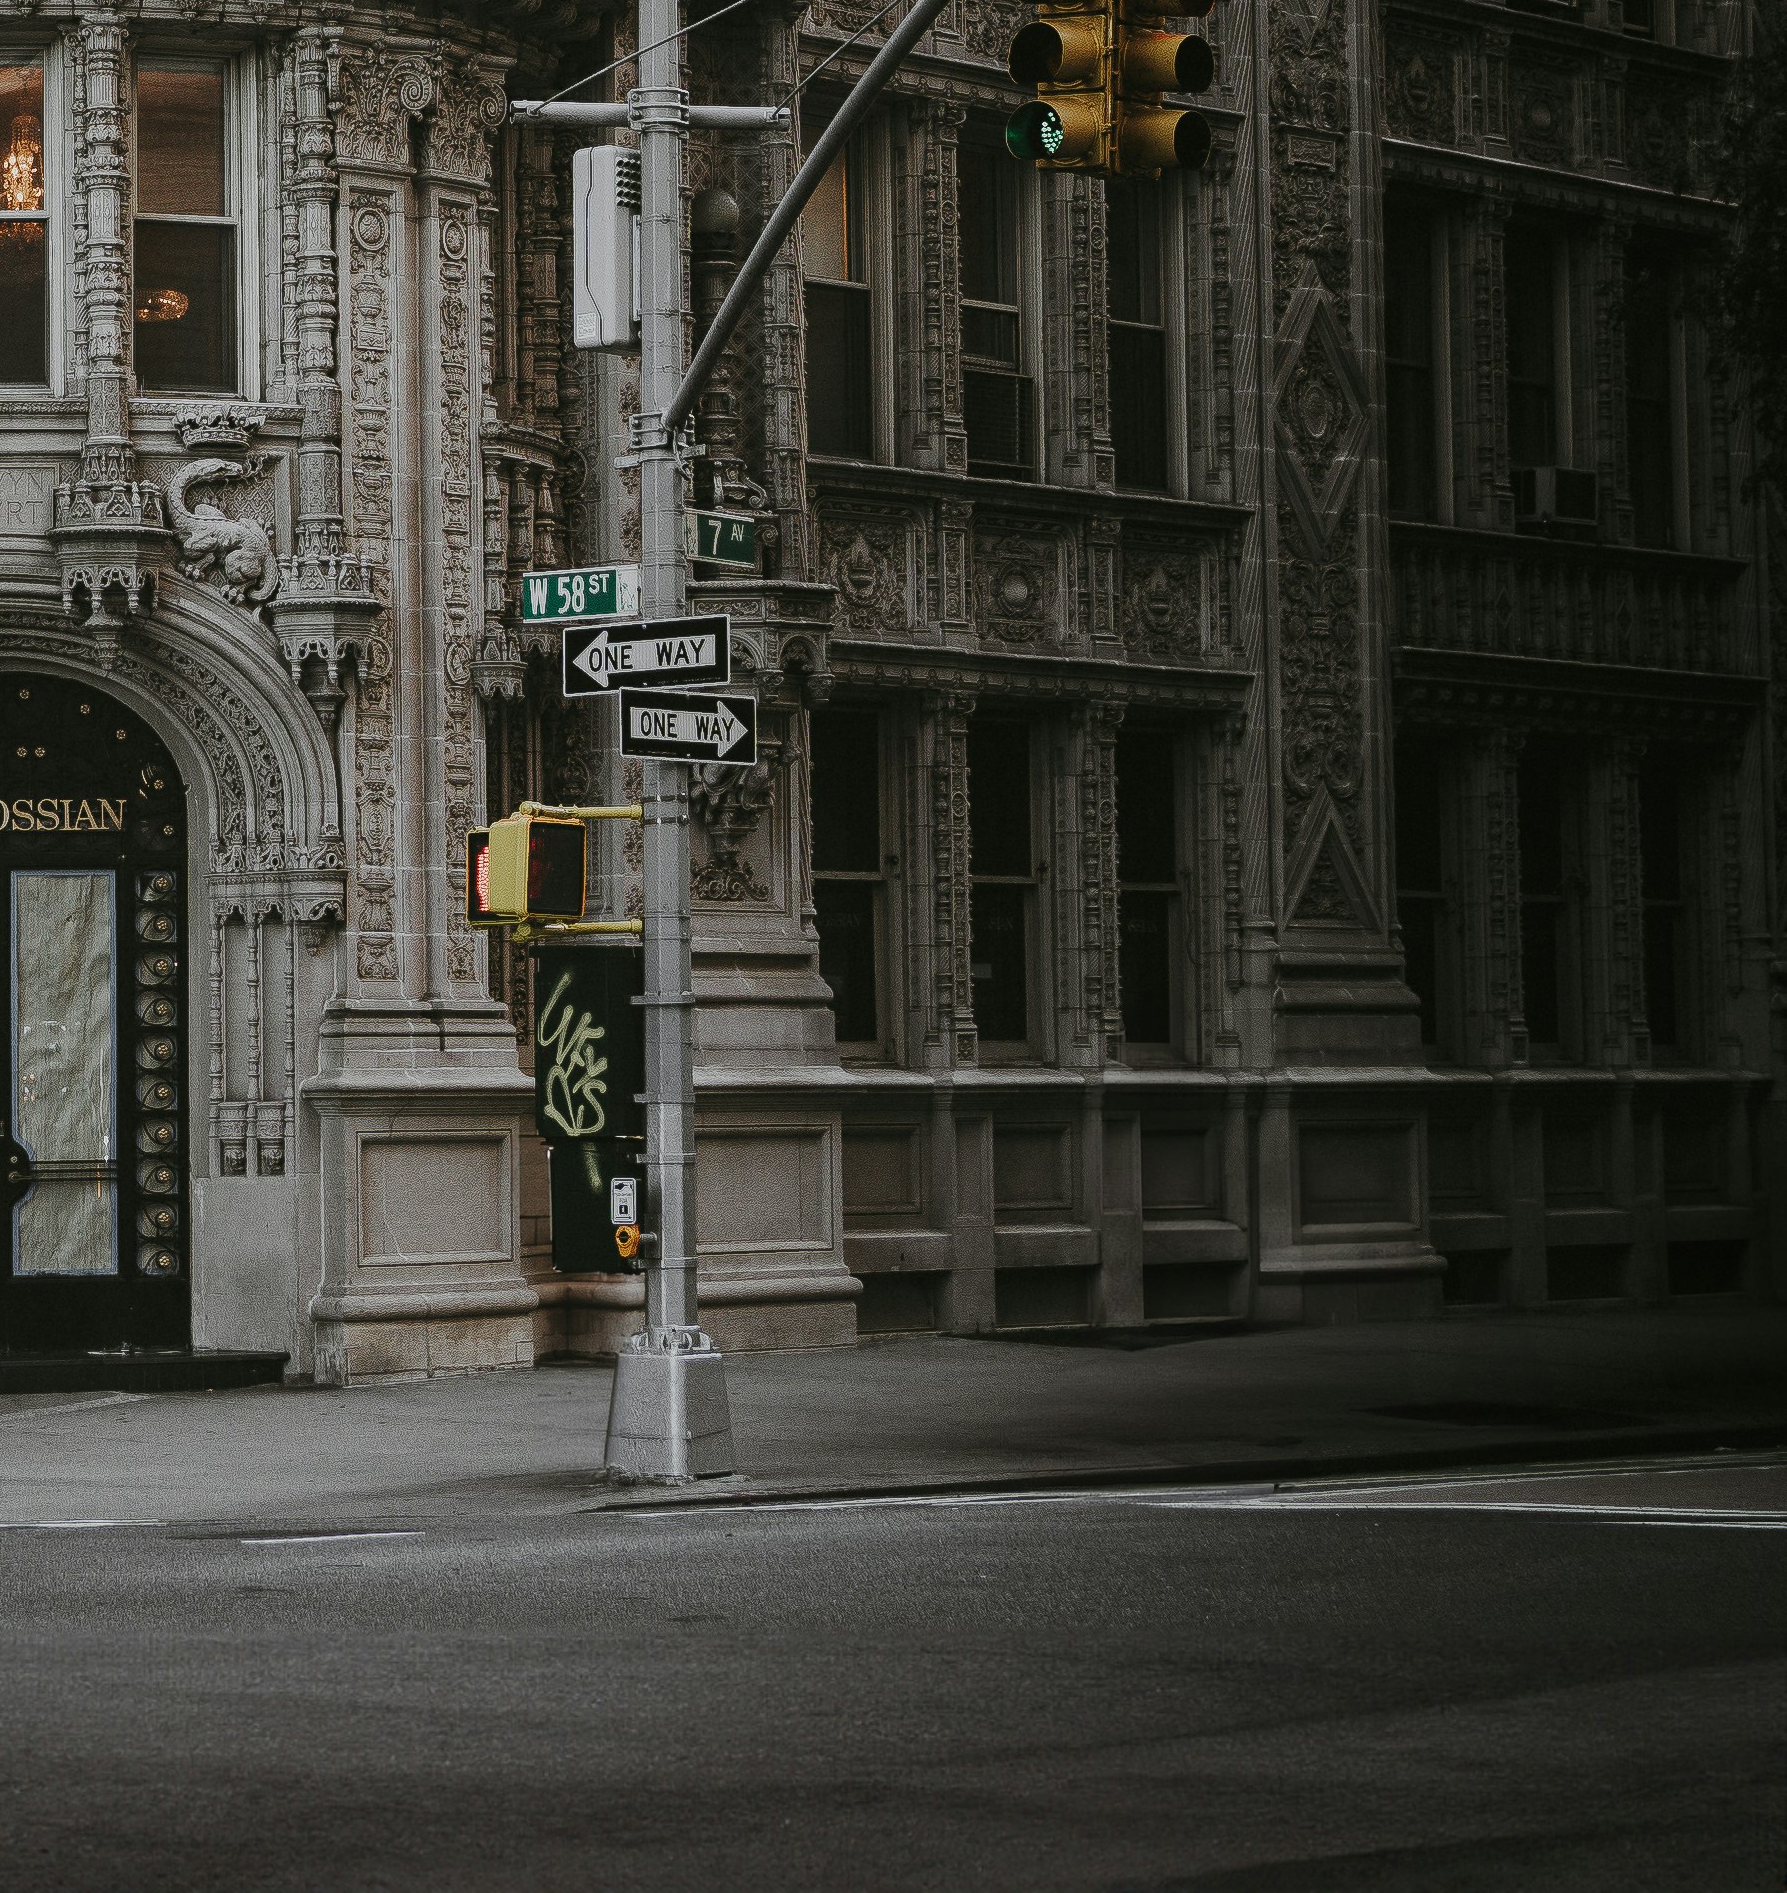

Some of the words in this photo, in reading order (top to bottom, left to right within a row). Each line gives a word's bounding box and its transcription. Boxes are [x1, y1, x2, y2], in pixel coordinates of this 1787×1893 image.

[707, 519, 722, 556] 7
[730, 522, 745, 542] AV
[528, 577, 548, 616] W
[557, 574, 586, 615] 58
[588, 573, 610, 595] ST
[588, 644, 634, 673] ONE
[655, 638, 706, 667] WAY
[640, 710, 678, 739] ONE
[695, 714, 735, 743] WAY
